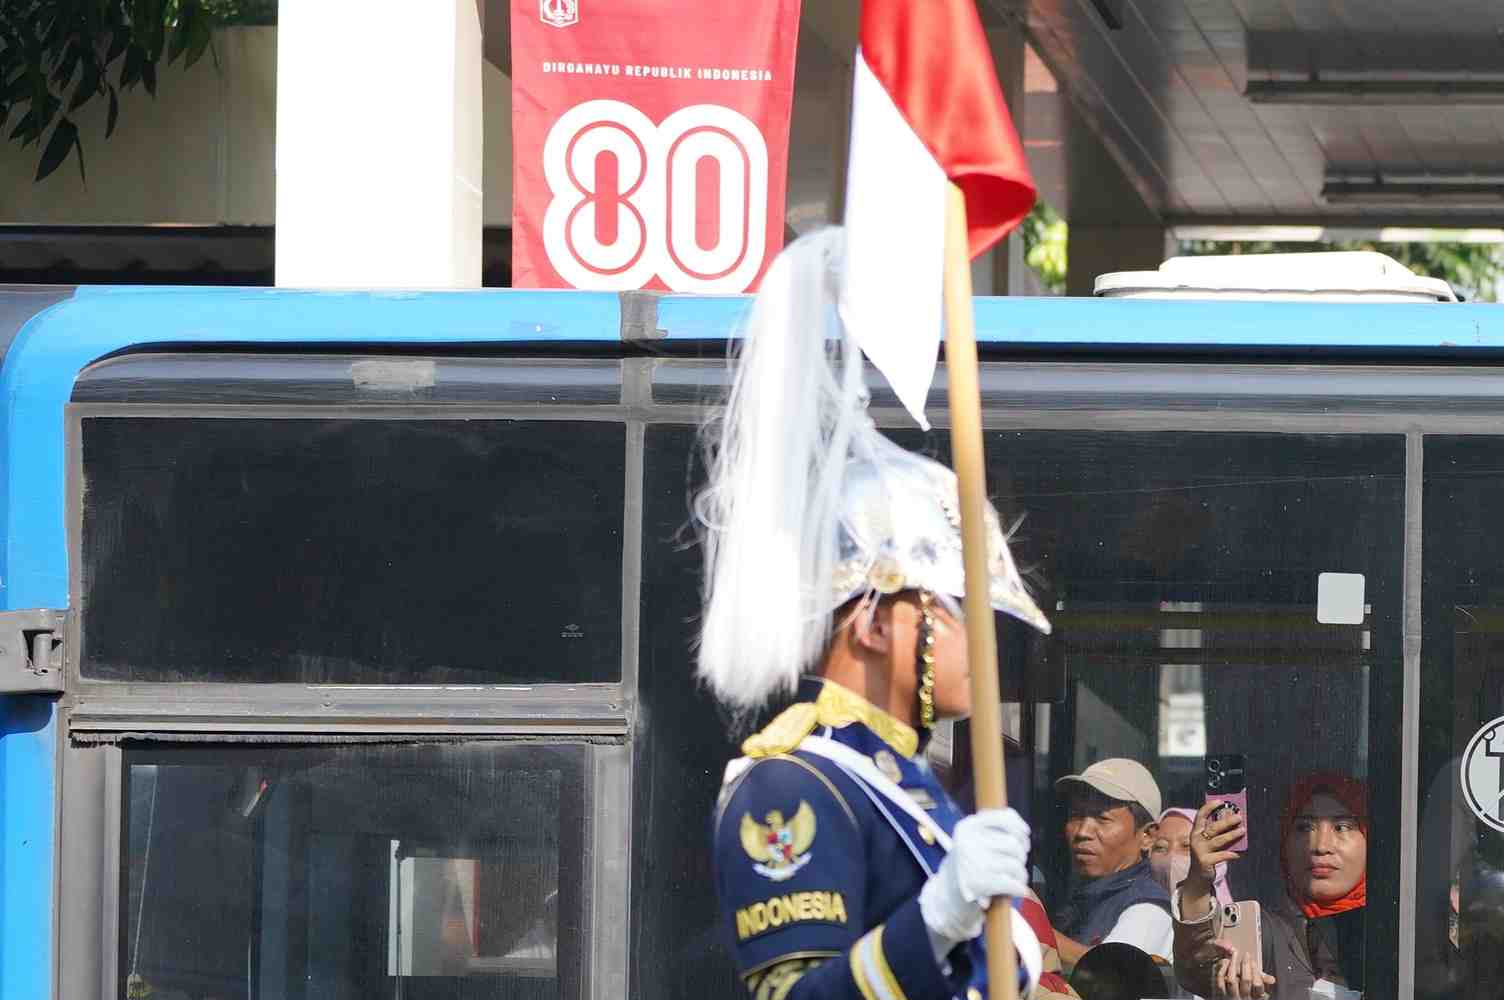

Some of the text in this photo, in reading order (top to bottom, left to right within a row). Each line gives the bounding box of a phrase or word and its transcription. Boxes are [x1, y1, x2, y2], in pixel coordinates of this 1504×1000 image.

[543, 61, 772, 81] DIRGAHAYU REPUBLIK INDONESIA
[543, 99, 768, 294] 80
[736, 890, 848, 940] INDONESIA
